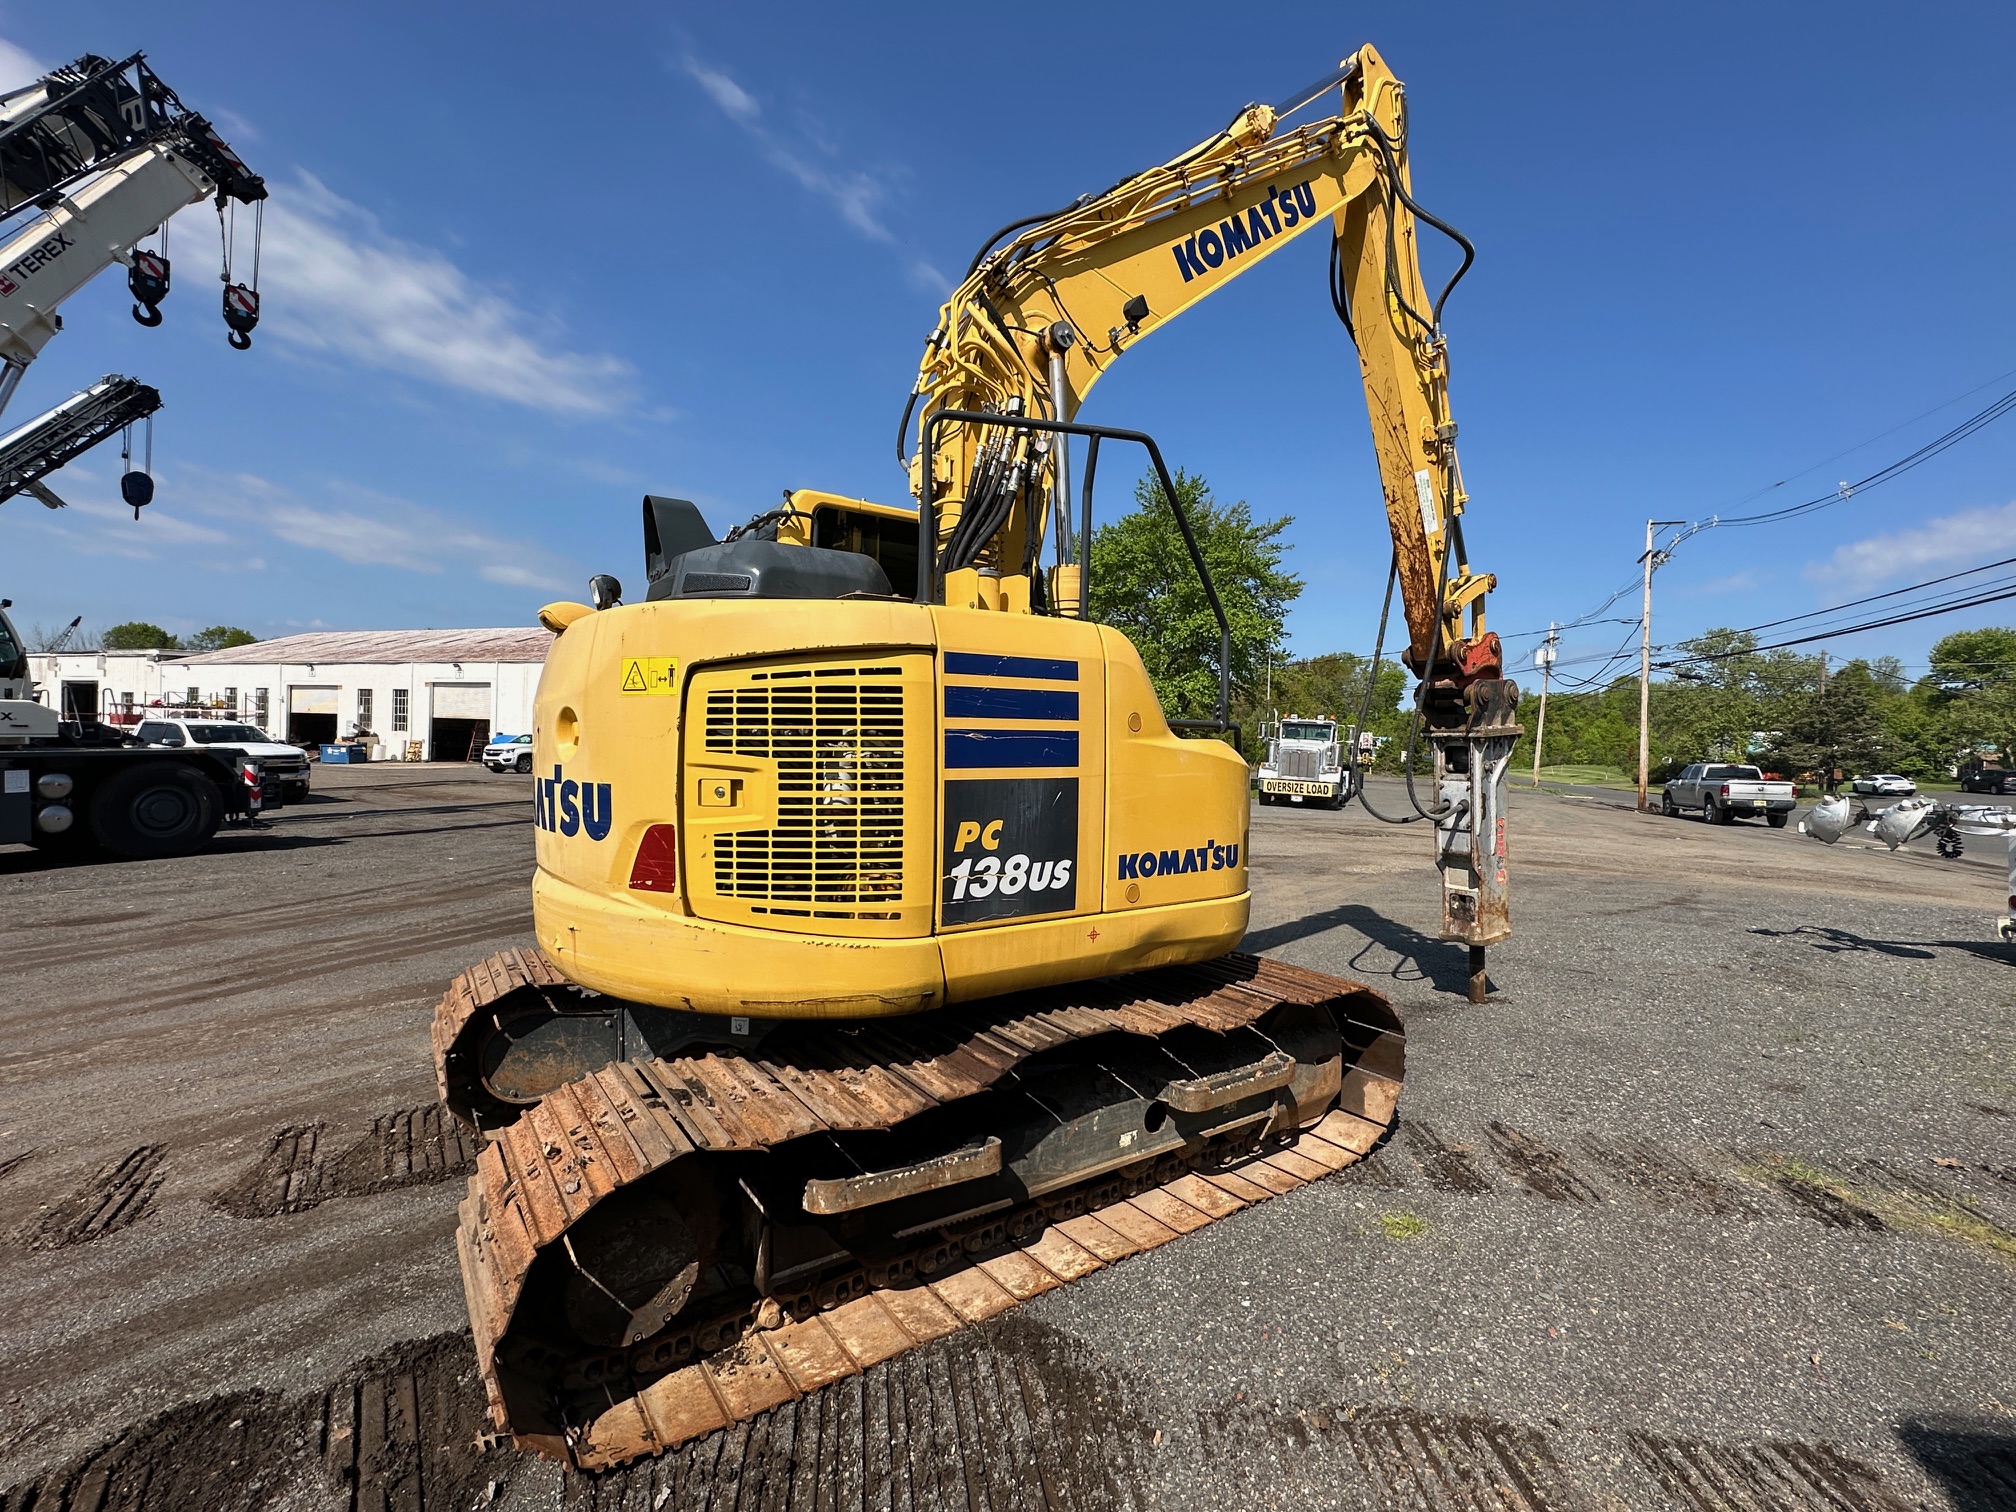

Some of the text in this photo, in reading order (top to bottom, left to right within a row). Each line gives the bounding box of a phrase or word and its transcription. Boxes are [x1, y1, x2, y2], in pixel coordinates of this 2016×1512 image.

[1172, 180, 1316, 283] KOMATSU
[8, 232, 74, 280] TEREX
[534, 764, 612, 841] ATSU
[1266, 781, 1329, 795] OVERSIZE LOAD
[953, 819, 1004, 853] PC
[1118, 839, 1239, 880] KOMATSU
[950, 853, 1073, 900] 138US
